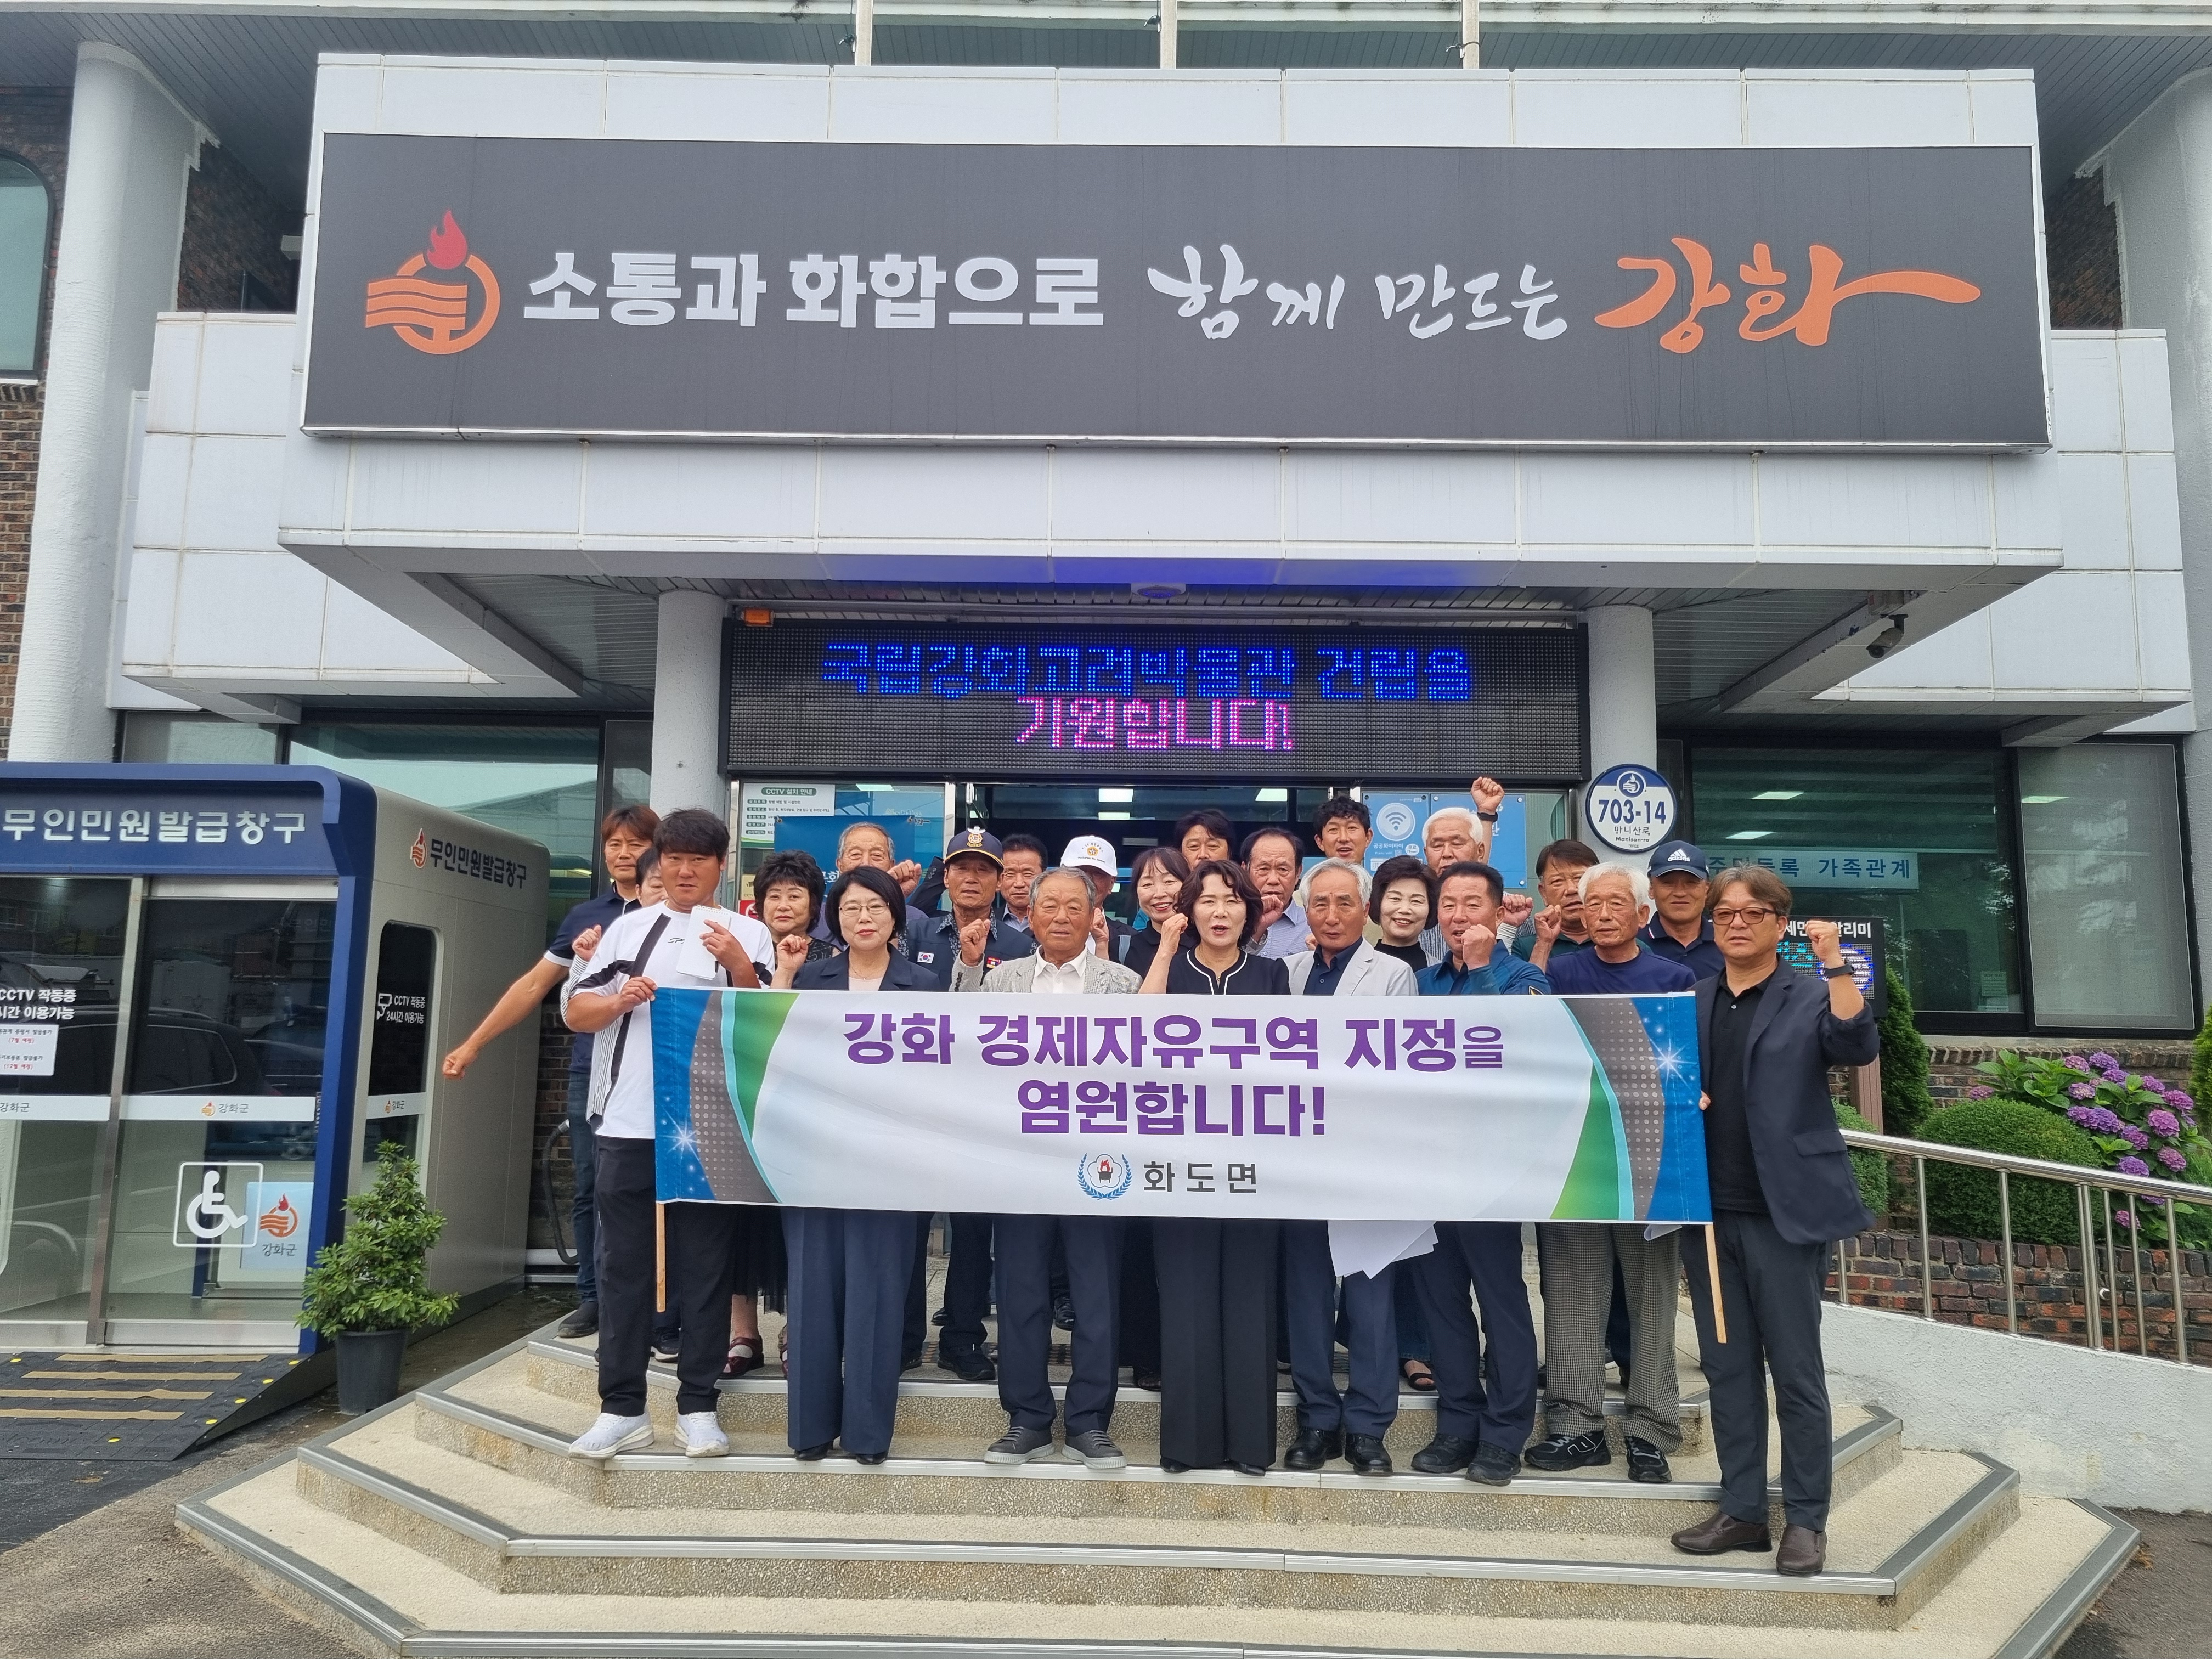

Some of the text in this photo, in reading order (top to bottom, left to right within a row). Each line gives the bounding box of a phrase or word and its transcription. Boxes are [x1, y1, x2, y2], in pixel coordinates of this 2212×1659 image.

[524, 239, 1979, 352] 소통과 화합으로 함께 만드는 강화
[824, 645, 1470, 700] 국립강화고려박물관 건립을
[1016, 697, 1293, 751] 기원합니다!
[1598, 799, 1666, 824] 703-14
[3, 809, 306, 844] 무인민원발급창구
[1615, 826, 1650, 836] 마니산로
[431, 839, 527, 889] 무인민원발급창구
[1819, 857, 1910, 879] 가족관계
[0, 989, 77, 1002] CCTV 작동중
[394, 995, 426, 1008] CCTV 작동중
[24, 1006, 76, 1020] 이용가능
[386, 1011, 425, 1024] 24시간 이용가능
[845, 1014, 1503, 1071] 강화 경제자유구역 지정을
[0, 1102, 30, 1113] 강화군
[218, 1103, 250, 1114] 강화군
[392, 1100, 405, 1110] 강화군
[1018, 1081, 1324, 1136] 염원합니다!
[262, 1243, 297, 1257] 강화군
